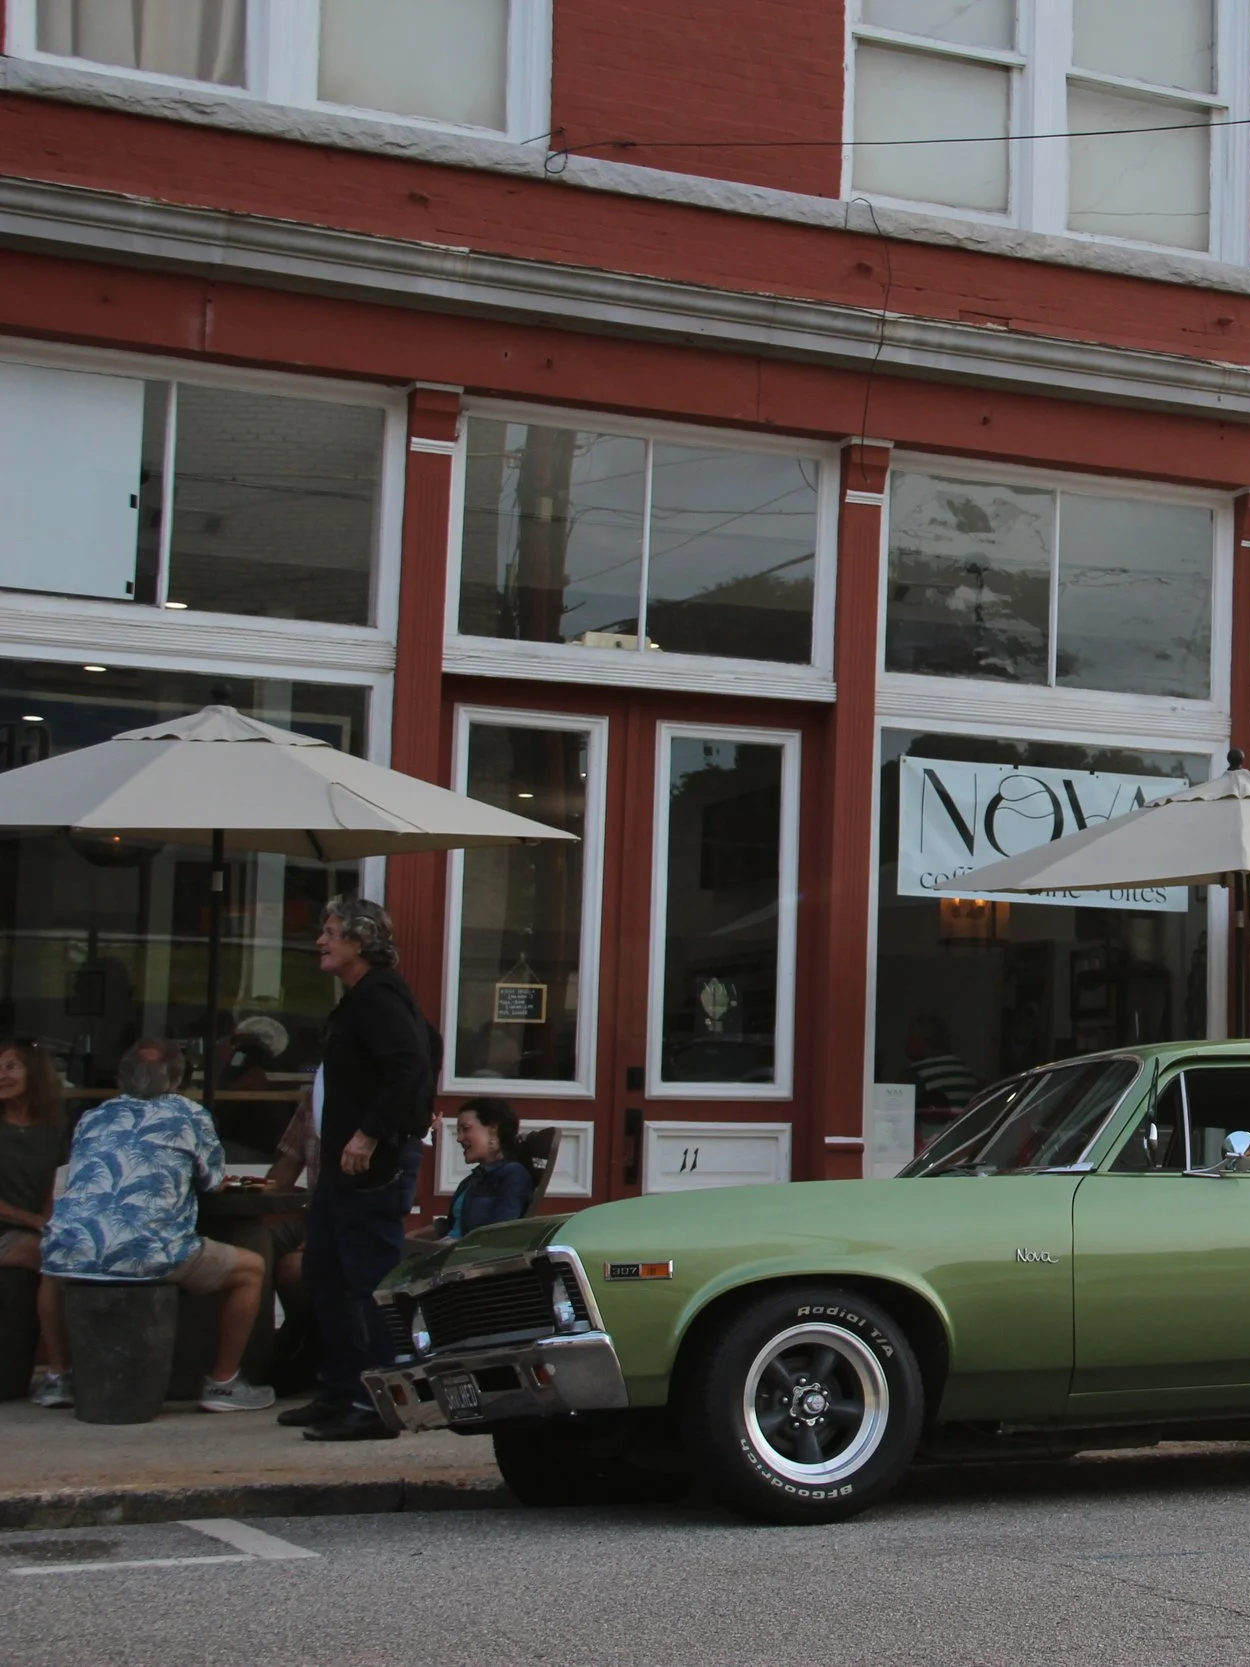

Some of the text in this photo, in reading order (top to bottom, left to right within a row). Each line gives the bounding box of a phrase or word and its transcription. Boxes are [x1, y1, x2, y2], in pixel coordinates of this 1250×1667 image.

[920, 768, 1145, 857] NOV
[679, 1148, 699, 1173] 11
[612, 1267, 637, 1275] 307
[1016, 1247, 1059, 1264] Nova
[797, 1305, 895, 1358] Radial T/A
[740, 1438, 854, 1499] BFGoodrich
